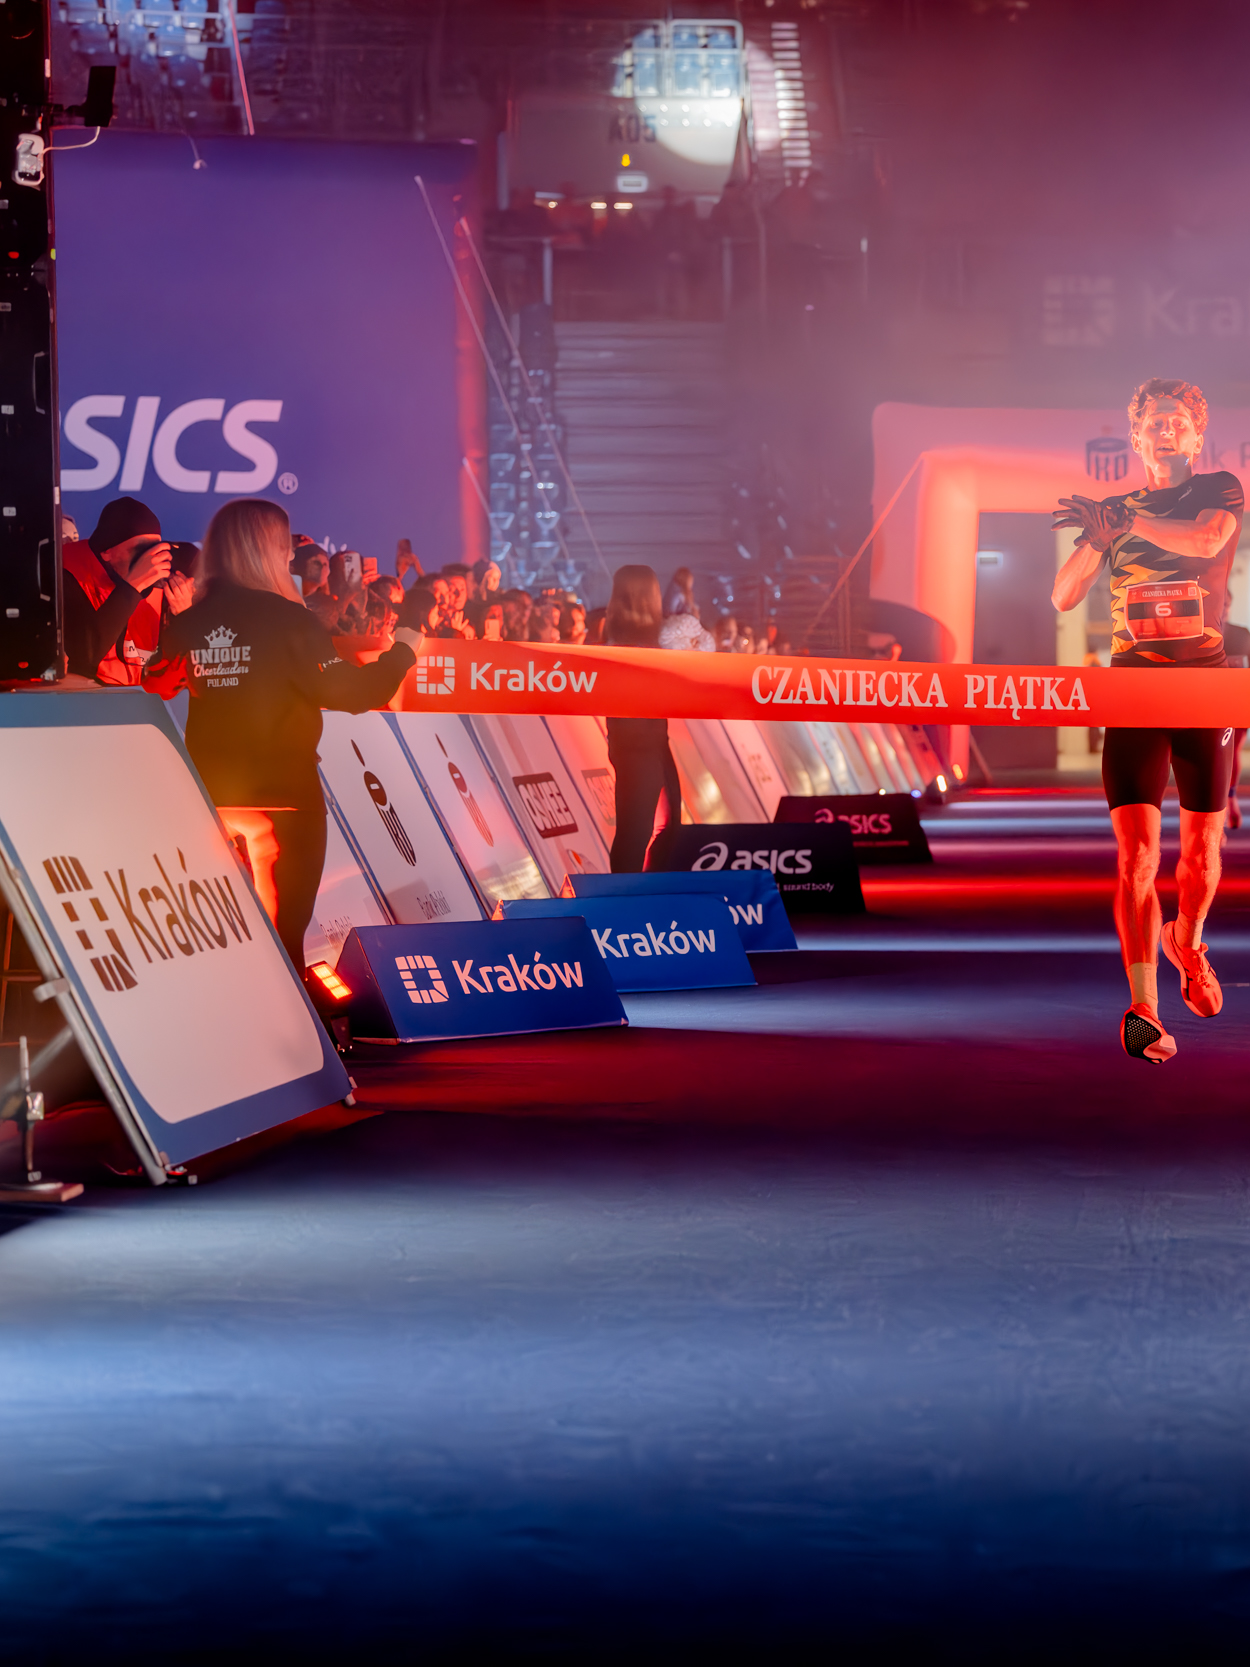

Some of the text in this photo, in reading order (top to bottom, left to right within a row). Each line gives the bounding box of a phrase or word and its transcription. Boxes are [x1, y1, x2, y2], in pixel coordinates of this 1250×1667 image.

[60, 395, 283, 493] SICS
[1155, 602, 1172, 617] 6
[190, 646, 251, 665] UNIQUE
[207, 677, 239, 687] POLAND
[470, 660, 598, 693] Kraków
[752, 665, 1091, 720] CZANIECKA PIĄTKA
[518, 780, 577, 832] OSHEE
[731, 849, 812, 874] asics
[103, 847, 253, 964] Kraków
[591, 920, 716, 959] Kraków
[451, 951, 584, 995] Kraków
